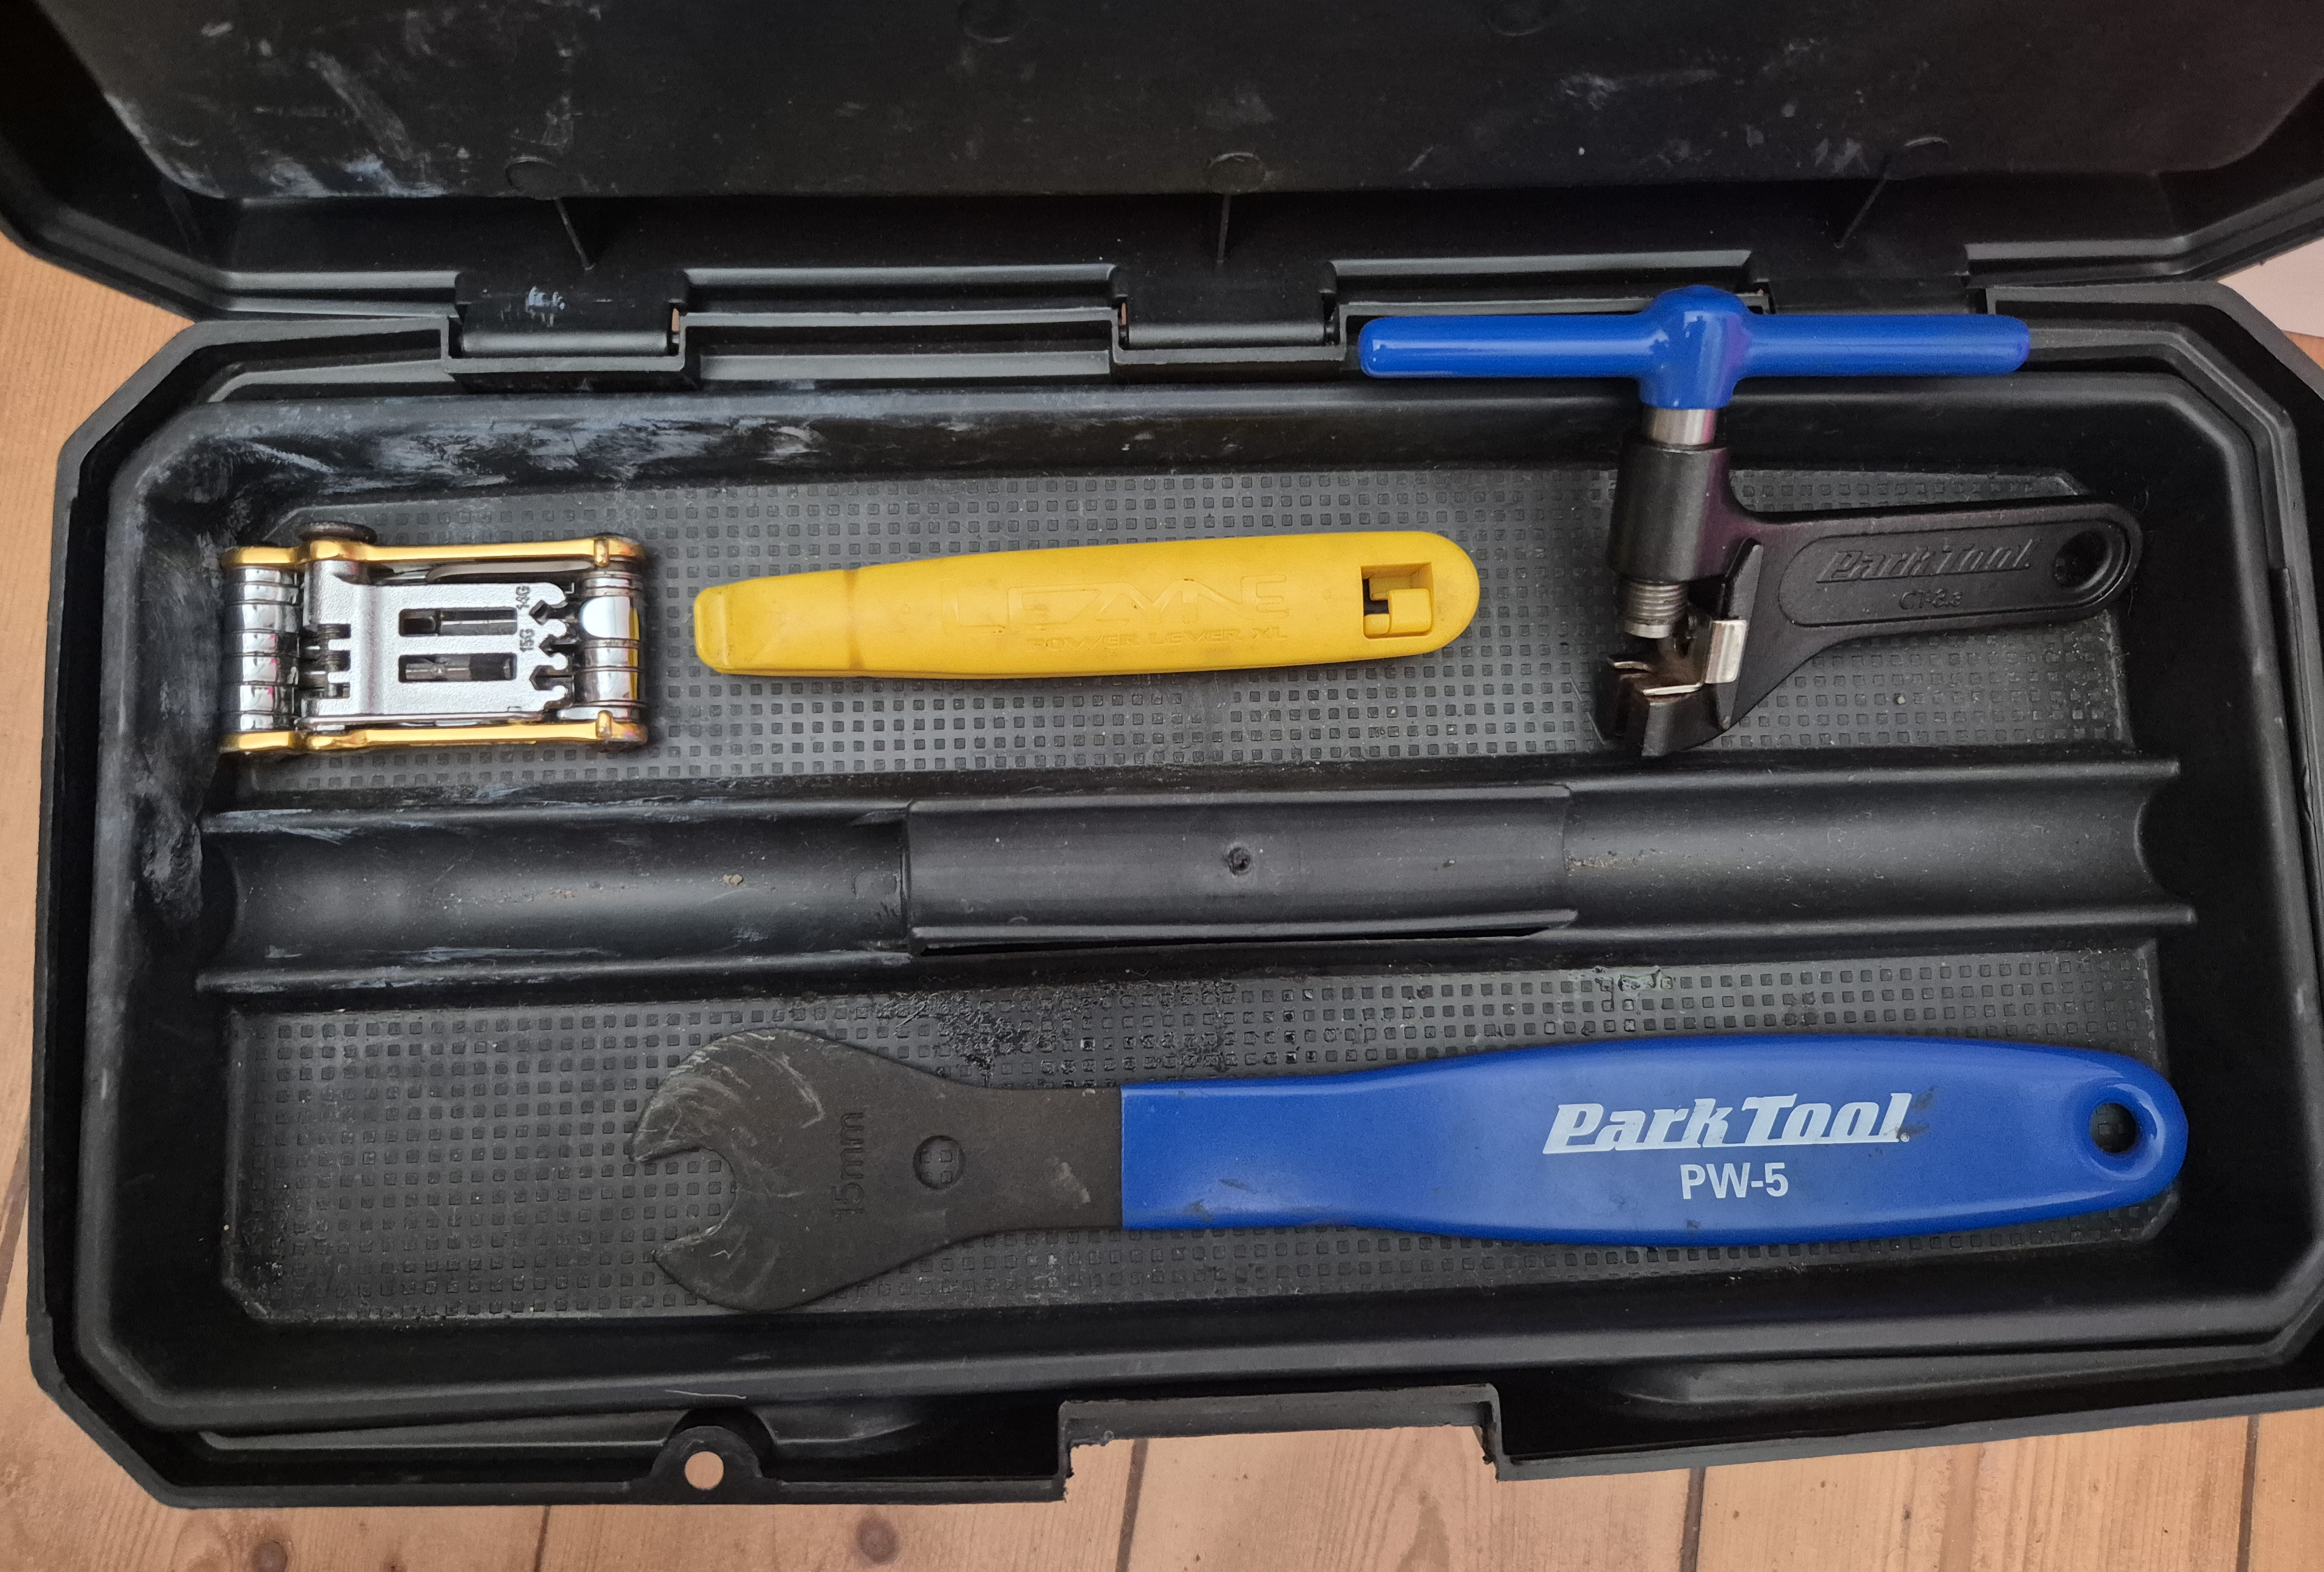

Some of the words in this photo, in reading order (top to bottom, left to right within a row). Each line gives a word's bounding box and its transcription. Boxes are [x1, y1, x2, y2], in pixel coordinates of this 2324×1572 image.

[519, 628, 534, 652] 15G
[1148, 628, 1241, 645] LEVER
[1253, 626, 1289, 641] XL
[832, 1112, 864, 1215] 15mm
[1680, 1162, 1789, 1199] PW-5
